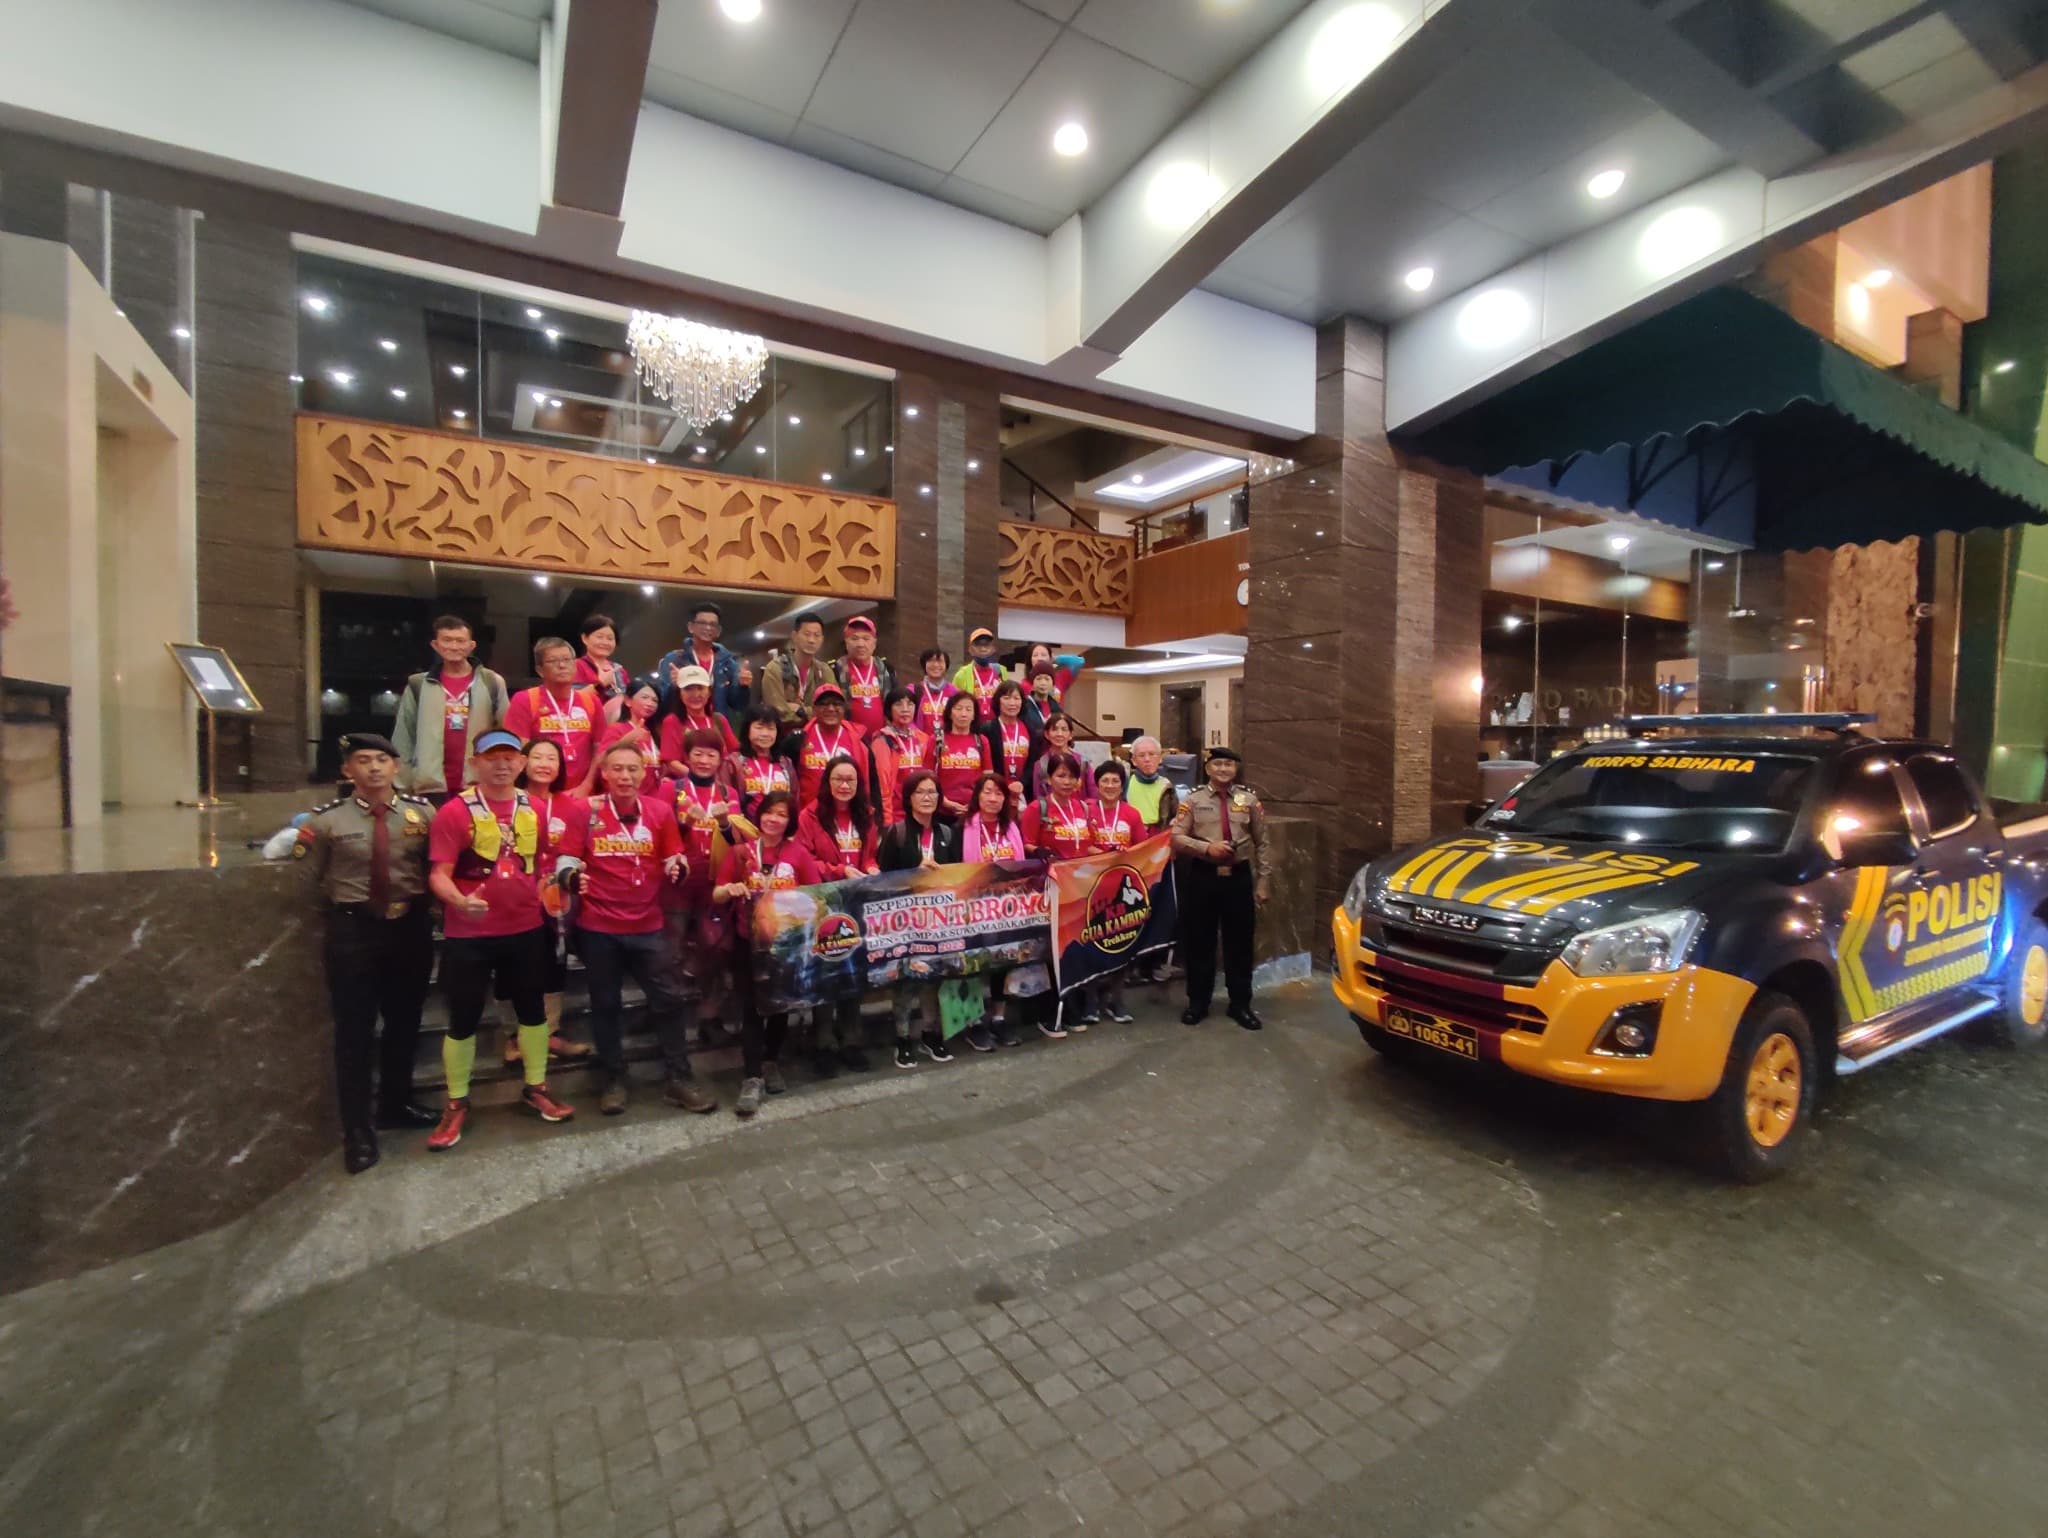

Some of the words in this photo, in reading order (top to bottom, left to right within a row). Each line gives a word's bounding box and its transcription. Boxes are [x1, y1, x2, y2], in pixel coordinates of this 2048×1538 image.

[1582, 756, 1648, 768] KORPS
[1648, 757, 1757, 773] SABHARA
[745, 778, 790, 792] Brmo
[1436, 839, 1700, 877] POLISI
[866, 894, 953, 914] EXPEDITION
[866, 903, 964, 938] MOUNT
[969, 894, 1051, 924] BROMO
[1415, 906, 1479, 930] ISUZU
[1907, 872, 2001, 942] POLISI
[1081, 924, 1105, 945] GUA
[1105, 905, 1151, 936] KAMBING
[1415, 1025, 1474, 1055] 1063-41
